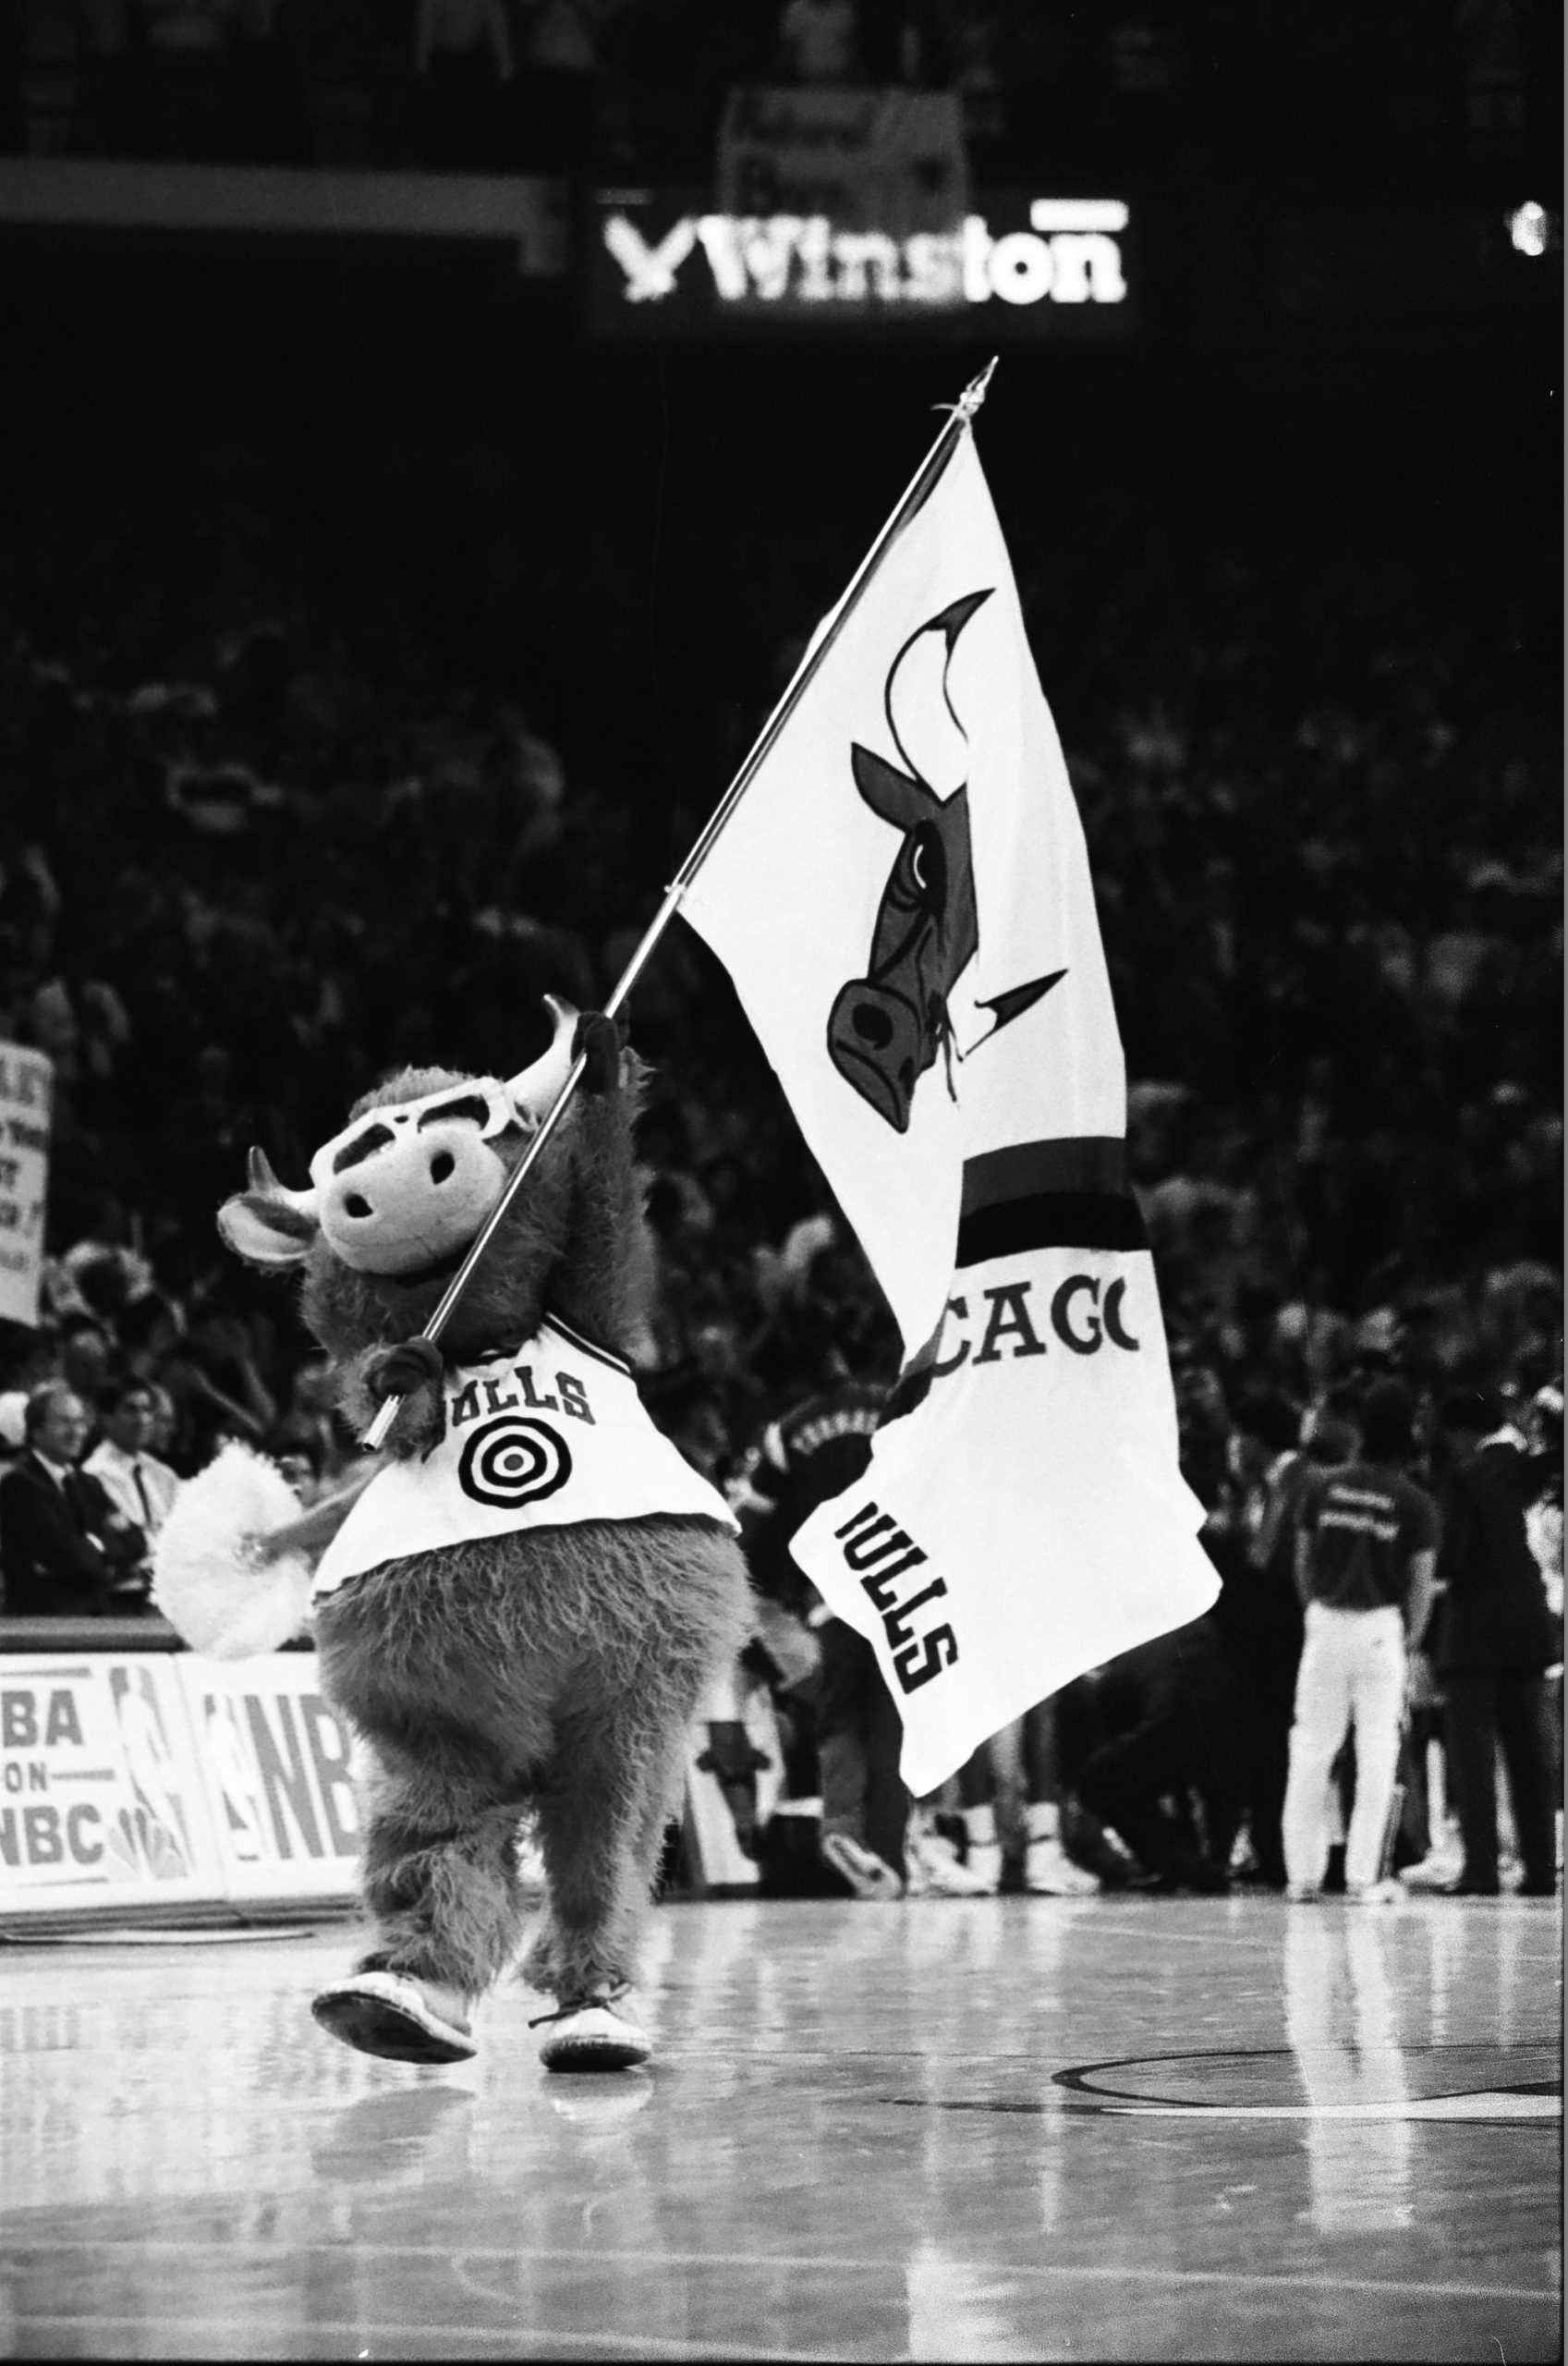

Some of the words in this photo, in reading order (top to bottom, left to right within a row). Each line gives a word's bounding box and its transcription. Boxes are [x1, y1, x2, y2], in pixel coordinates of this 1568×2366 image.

[696, 213, 1126, 303] Winston
[834, 1501, 958, 1694] ULLS
[0, 1689, 83, 1749] BA
[5, 1762, 48, 1792] ON
[244, 1694, 361, 1860] NB
